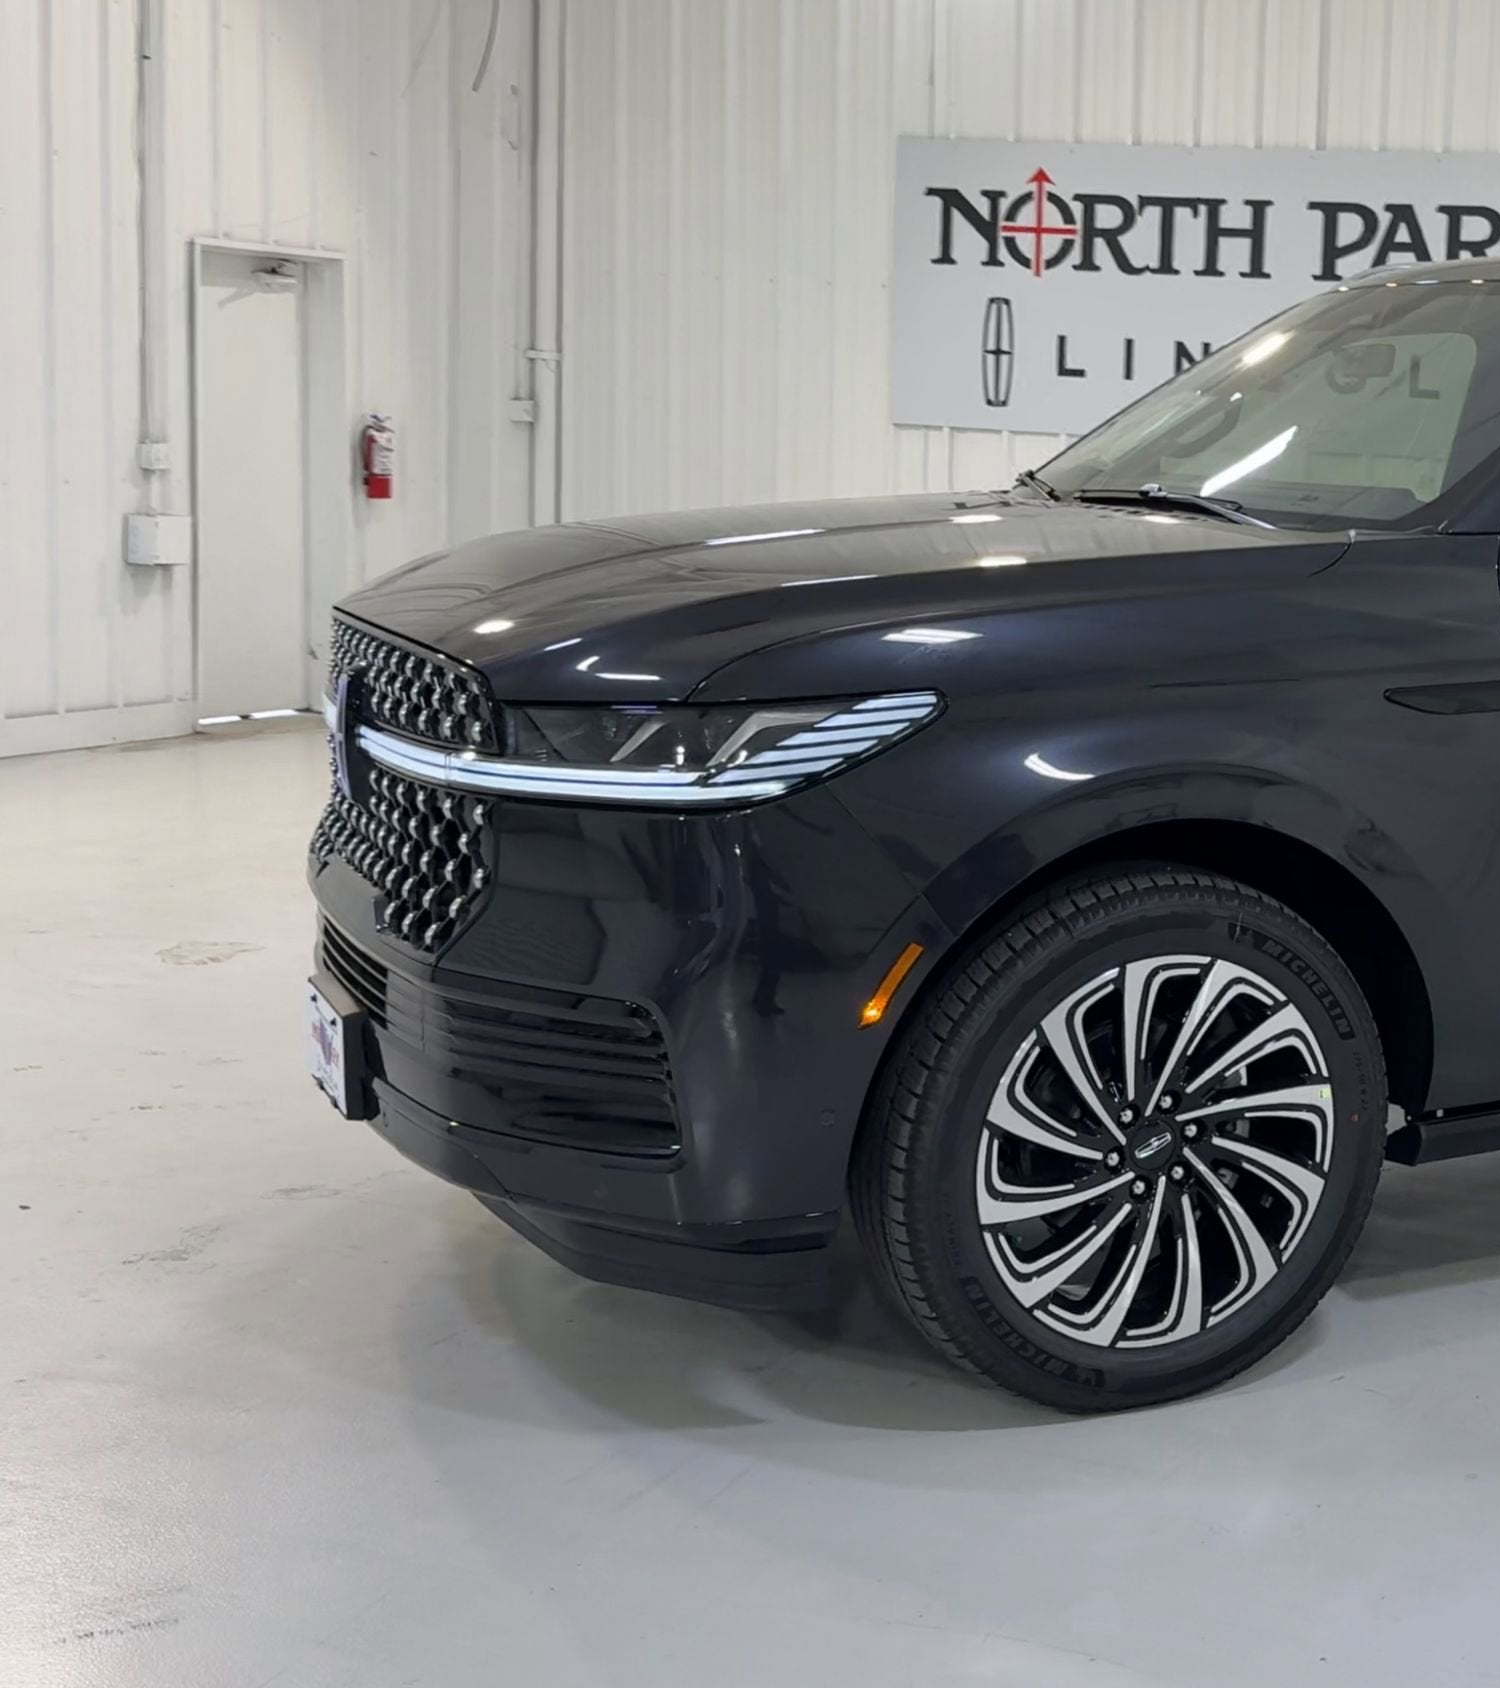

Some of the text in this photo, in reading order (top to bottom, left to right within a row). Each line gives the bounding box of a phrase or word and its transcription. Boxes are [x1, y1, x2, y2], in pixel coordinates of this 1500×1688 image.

[925, 187, 1274, 279] NORTH
[1261, 938, 1352, 1036] MICHELIN
[962, 1280, 1075, 1378] MICHELIN
